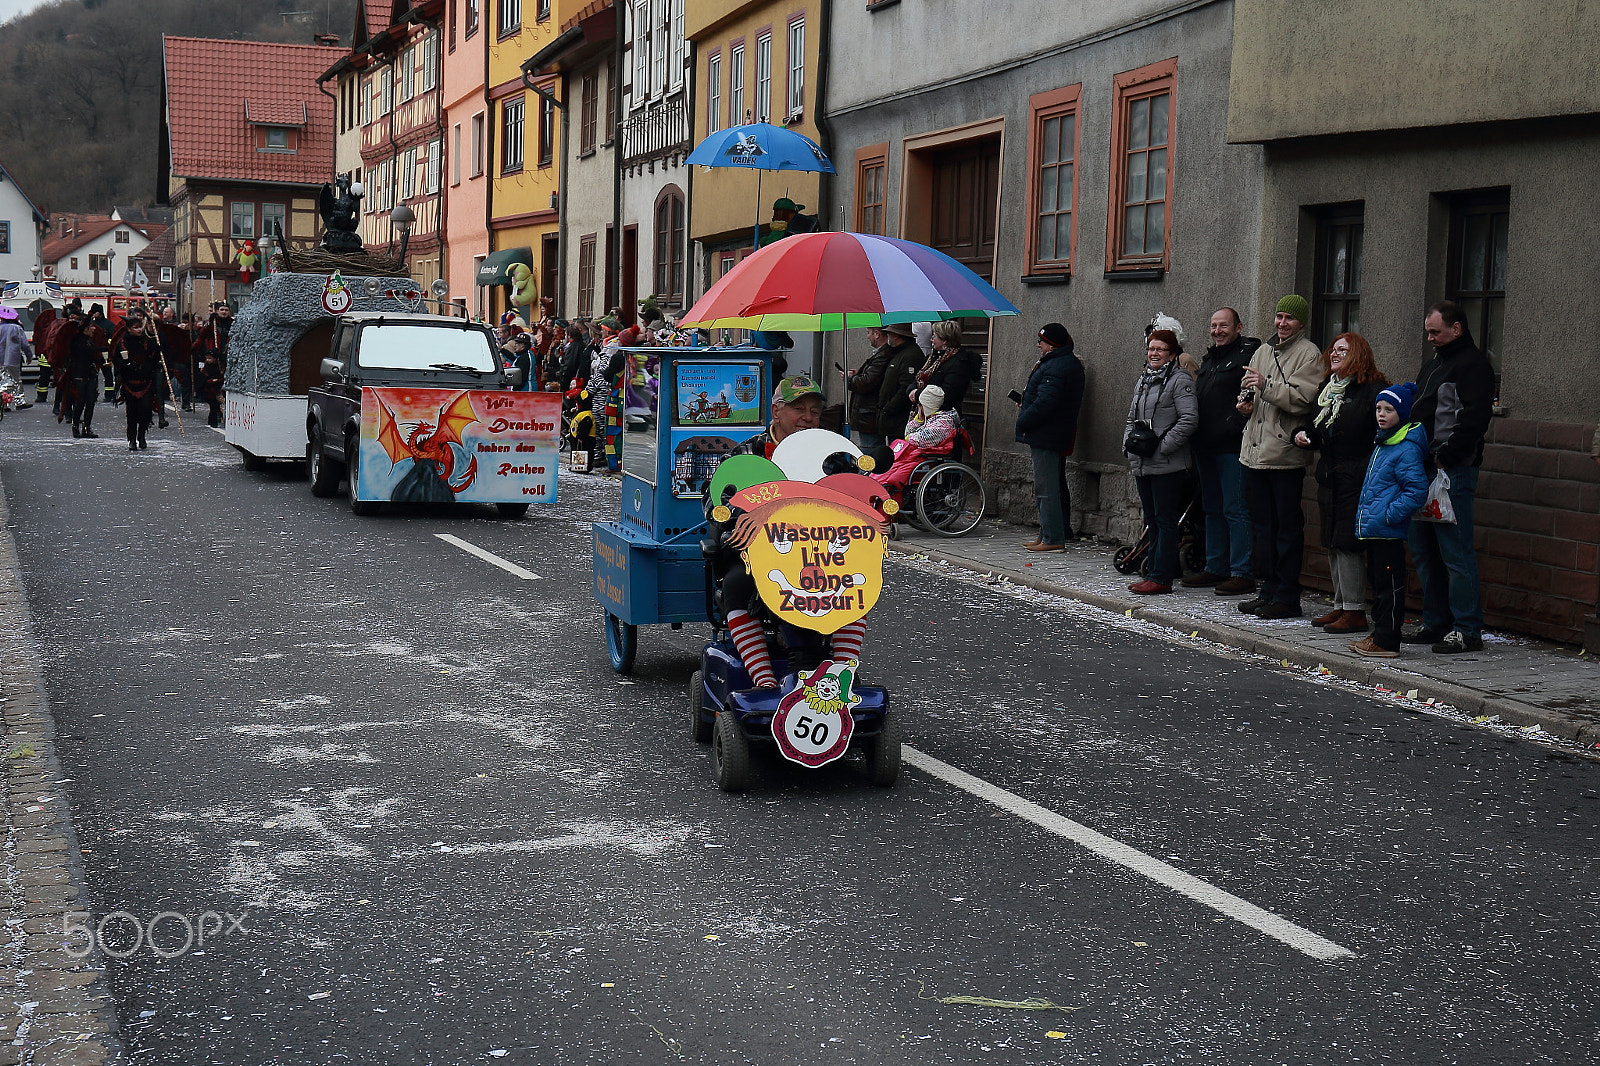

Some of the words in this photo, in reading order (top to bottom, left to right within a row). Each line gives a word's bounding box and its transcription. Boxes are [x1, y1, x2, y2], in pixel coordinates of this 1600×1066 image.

[732, 156, 757, 165] VADER
[331, 296, 344, 307] 51
[485, 396, 515, 410] Wir
[487, 417, 555, 434] Drachen
[477, 442, 511, 453] haben
[515, 442, 536, 453] den
[496, 462, 545, 478] Rachen
[521, 485, 546, 496] voll
[742, 484, 782, 505] 482
[763, 522, 876, 546] Wasungen
[801, 547, 845, 568] Live
[799, 569, 854, 593] ohne
[793, 715, 829, 746] 50
